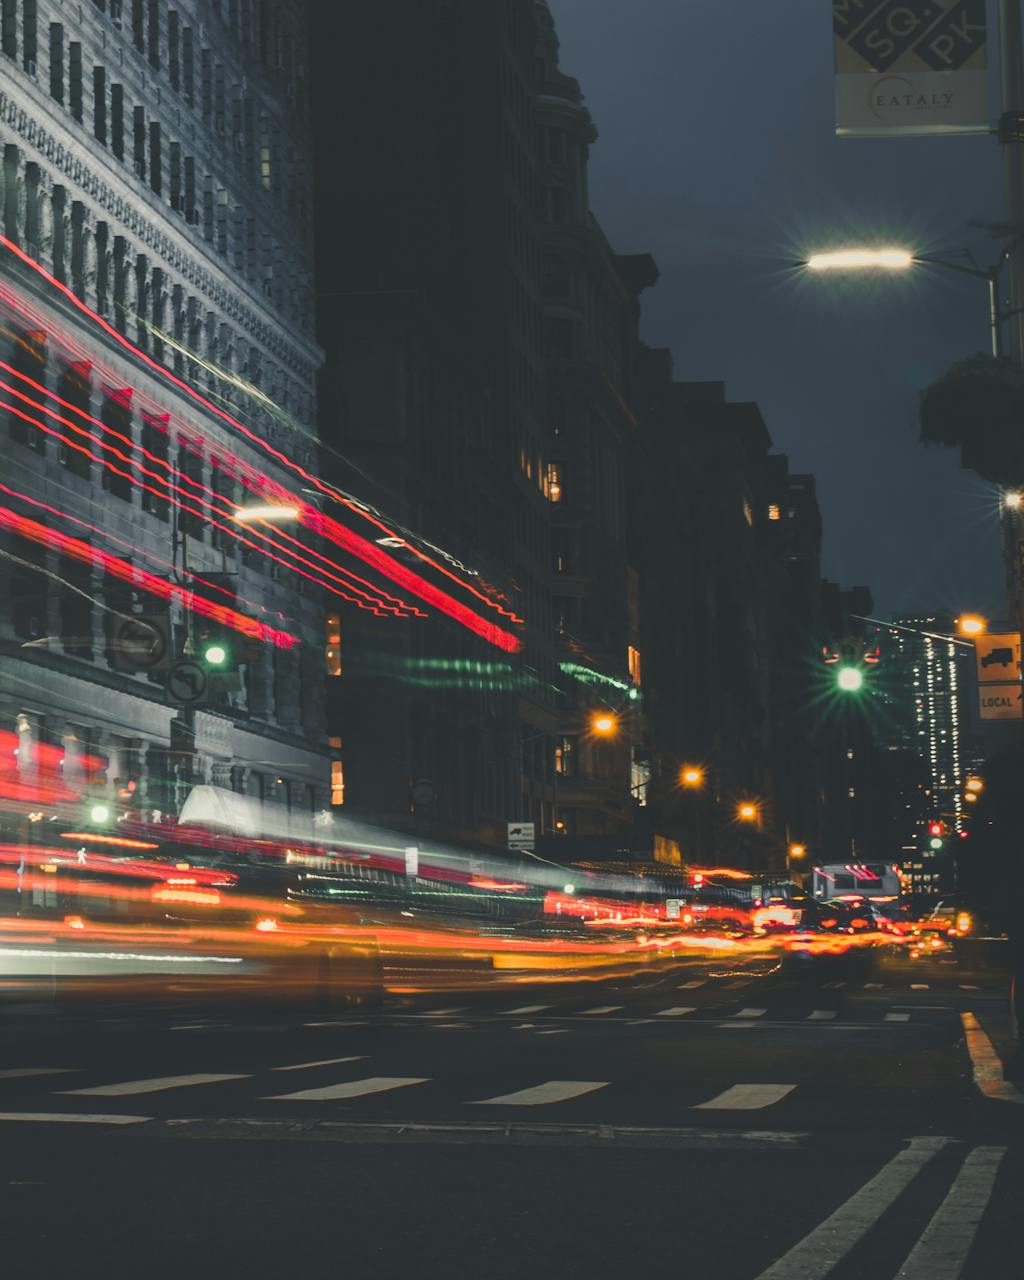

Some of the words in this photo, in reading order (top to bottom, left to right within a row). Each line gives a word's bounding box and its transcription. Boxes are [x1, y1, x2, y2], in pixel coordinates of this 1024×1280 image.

[864, 7, 932, 58] SQ.
[875, 93, 954, 106] EATALY
[981, 697, 1012, 708] LOCAL
